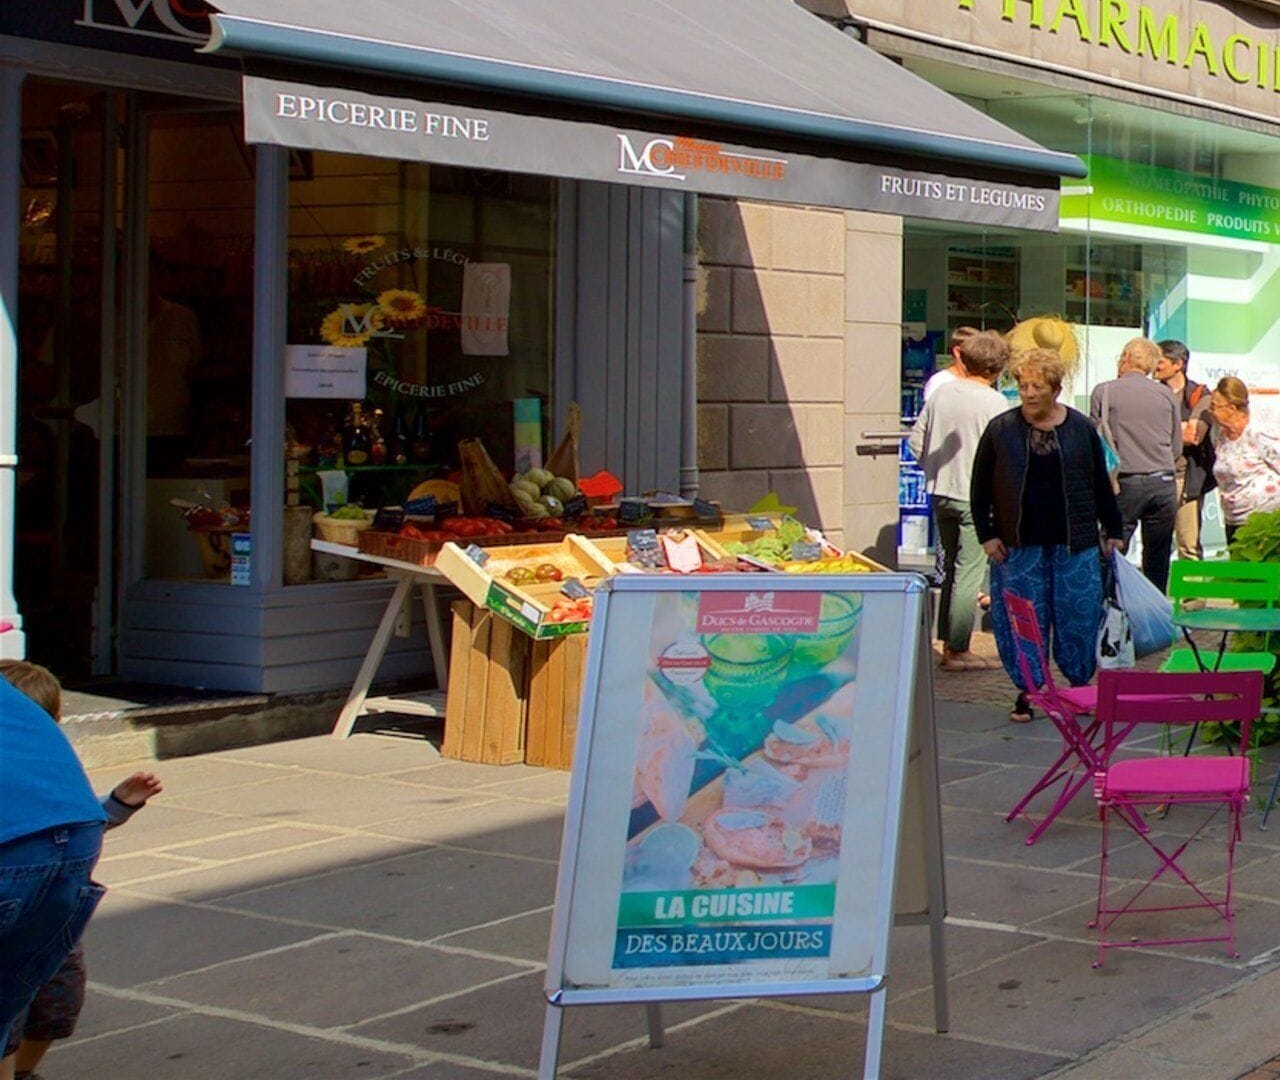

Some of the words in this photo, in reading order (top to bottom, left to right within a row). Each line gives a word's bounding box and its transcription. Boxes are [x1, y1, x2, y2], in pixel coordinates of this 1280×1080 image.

[277, 93, 418, 132] EPICERIE
[424, 113, 490, 141] FINE
[881, 175, 942, 200] FRUITS
[946, 184, 967, 201] ET
[970, 186, 1045, 211] LEGUMES
[1102, 197, 1198, 224] ORTHOPEDIE
[1207, 213, 1270, 235] PRODUITS
[353, 248, 411, 287] FRUITS
[449, 372, 485, 395] FINE
[1205, 367, 1239, 379] VICHY
[654, 896, 685, 919] LA
[691, 891, 795, 917] CUISINE
[624, 934, 669, 954] DES
[671, 931, 748, 954] BEAUX
[746, 930, 824, 951] JOURS
